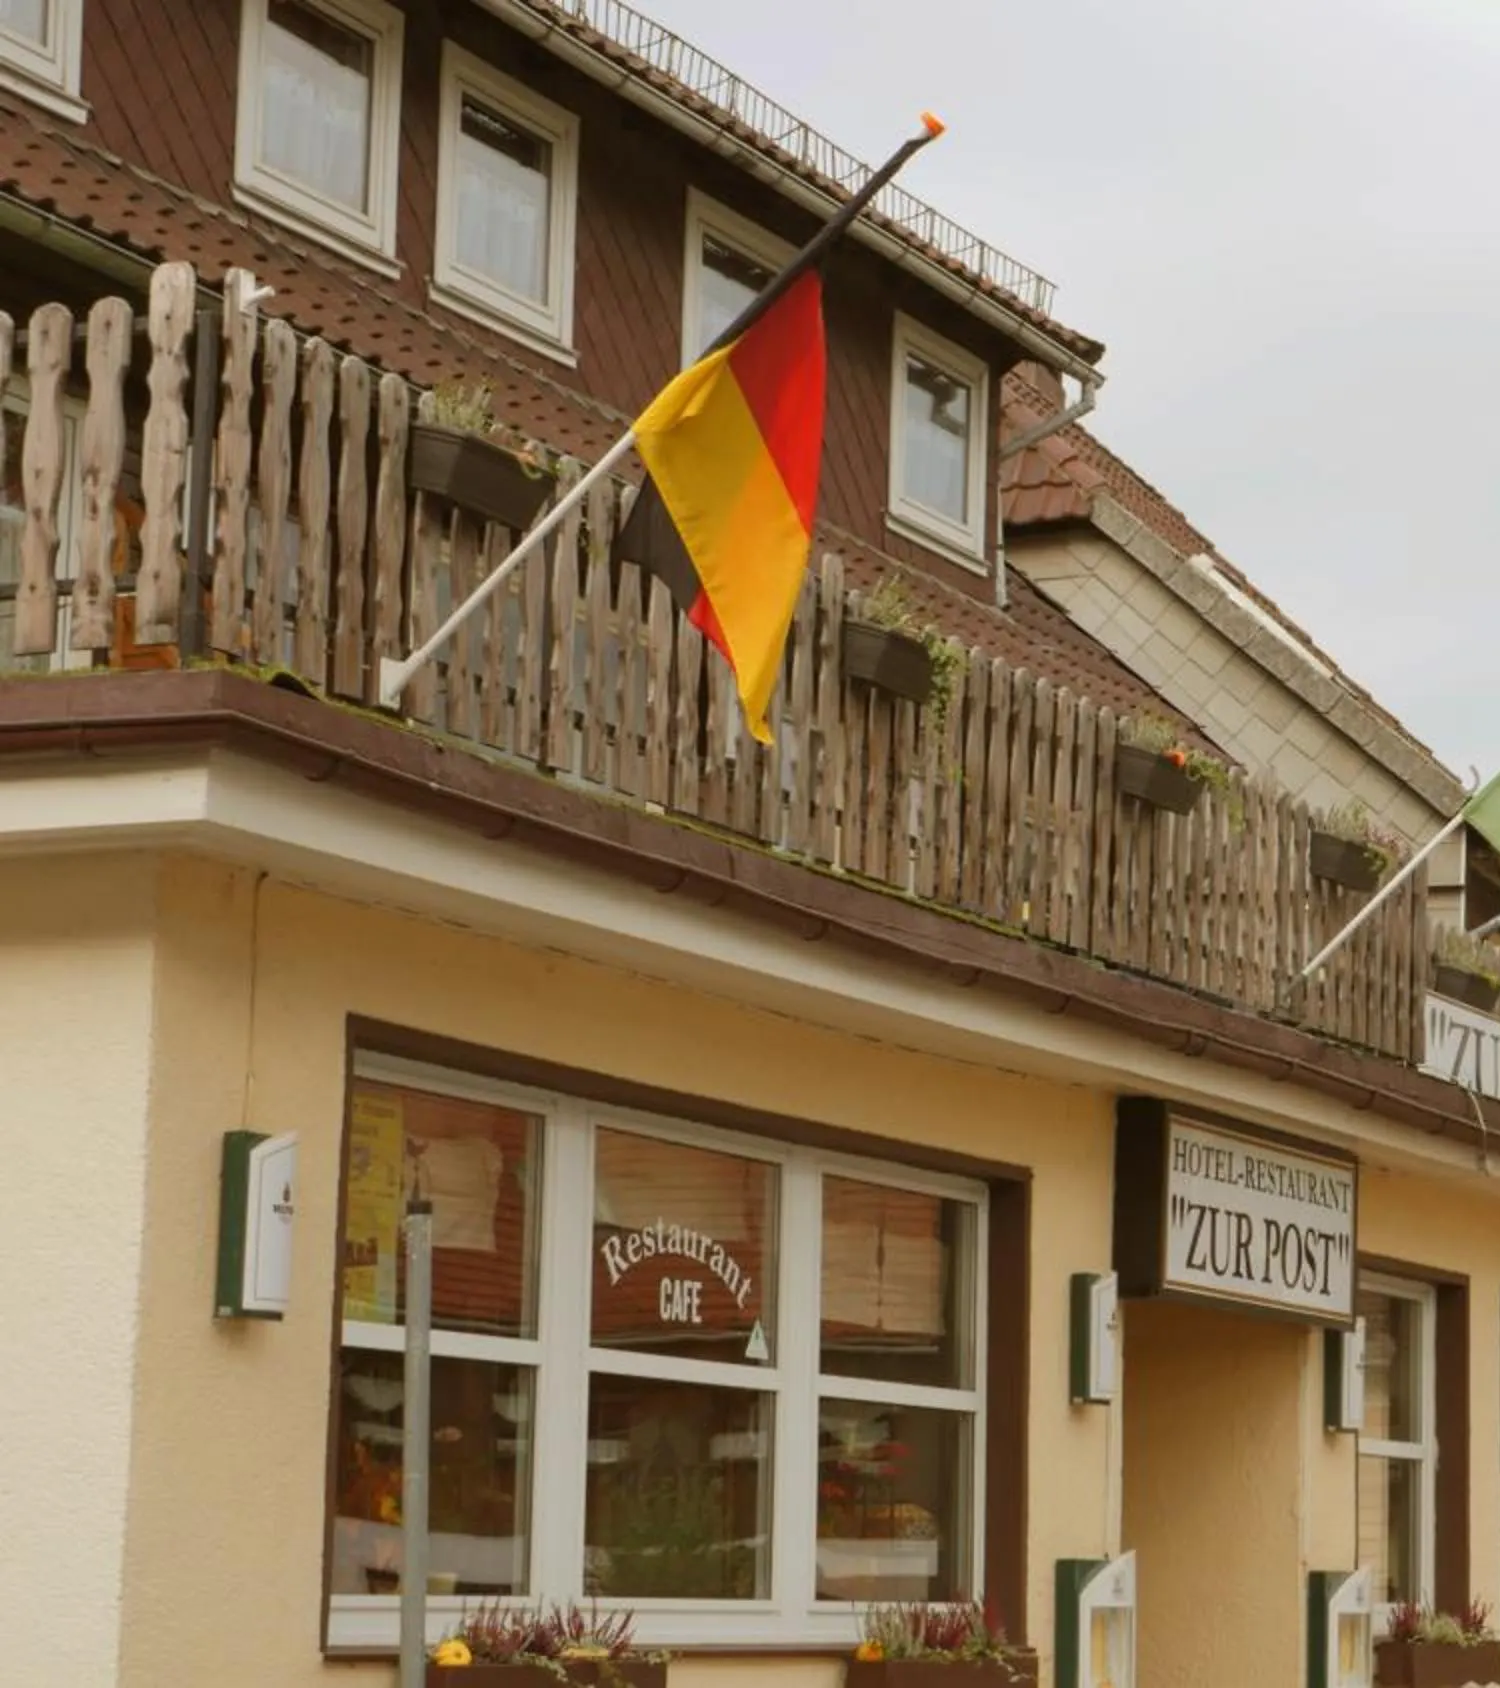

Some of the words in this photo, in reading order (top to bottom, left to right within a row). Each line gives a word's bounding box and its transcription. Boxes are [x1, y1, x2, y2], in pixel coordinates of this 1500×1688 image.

[1173, 1137, 1351, 1214] HOTEL-RESTAURANT
[601, 1216, 752, 1309] Restaurant
[1172, 1193, 1254, 1281] "ZUR
[1261, 1218, 1350, 1297] POST"
[660, 1277, 702, 1323] CAFE
